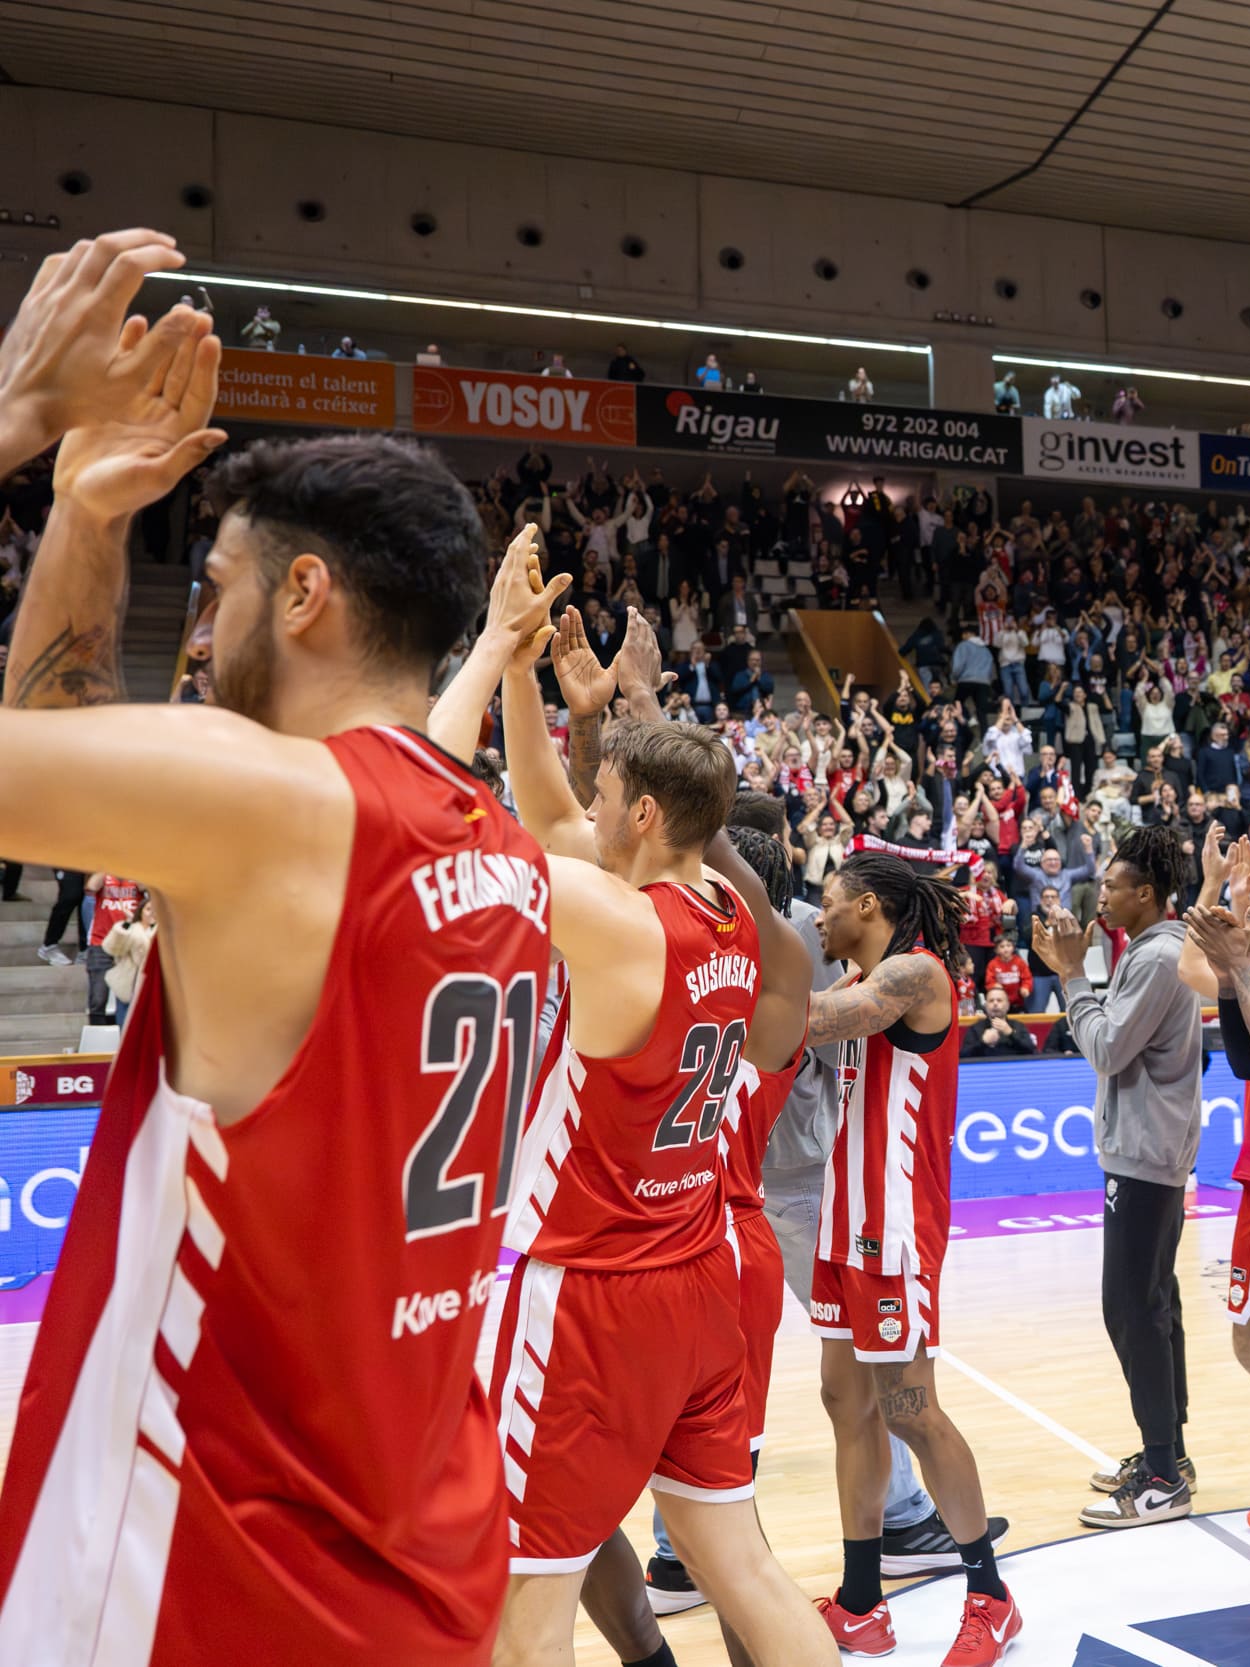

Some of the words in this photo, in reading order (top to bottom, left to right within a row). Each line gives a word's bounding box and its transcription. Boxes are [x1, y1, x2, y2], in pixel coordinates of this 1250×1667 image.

[300, 373, 317, 389] el
[323, 376, 377, 395] talent
[296, 400, 307, 410] a
[313, 396, 378, 415] créixer
[676, 405, 780, 445] Rigau
[862, 413, 897, 432] 972
[903, 416, 939, 435] 202
[945, 420, 979, 439] 004
[826, 434, 1008, 465] WWW.RIGAU.CAT
[1039, 431, 1186, 472] ginvest
[57, 1076, 94, 1095] BG
[651, 1018, 747, 1152] 29
[403, 972, 538, 1243] 21
[634, 1177, 678, 1198] Kave
[678, 1168, 716, 1194] Home
